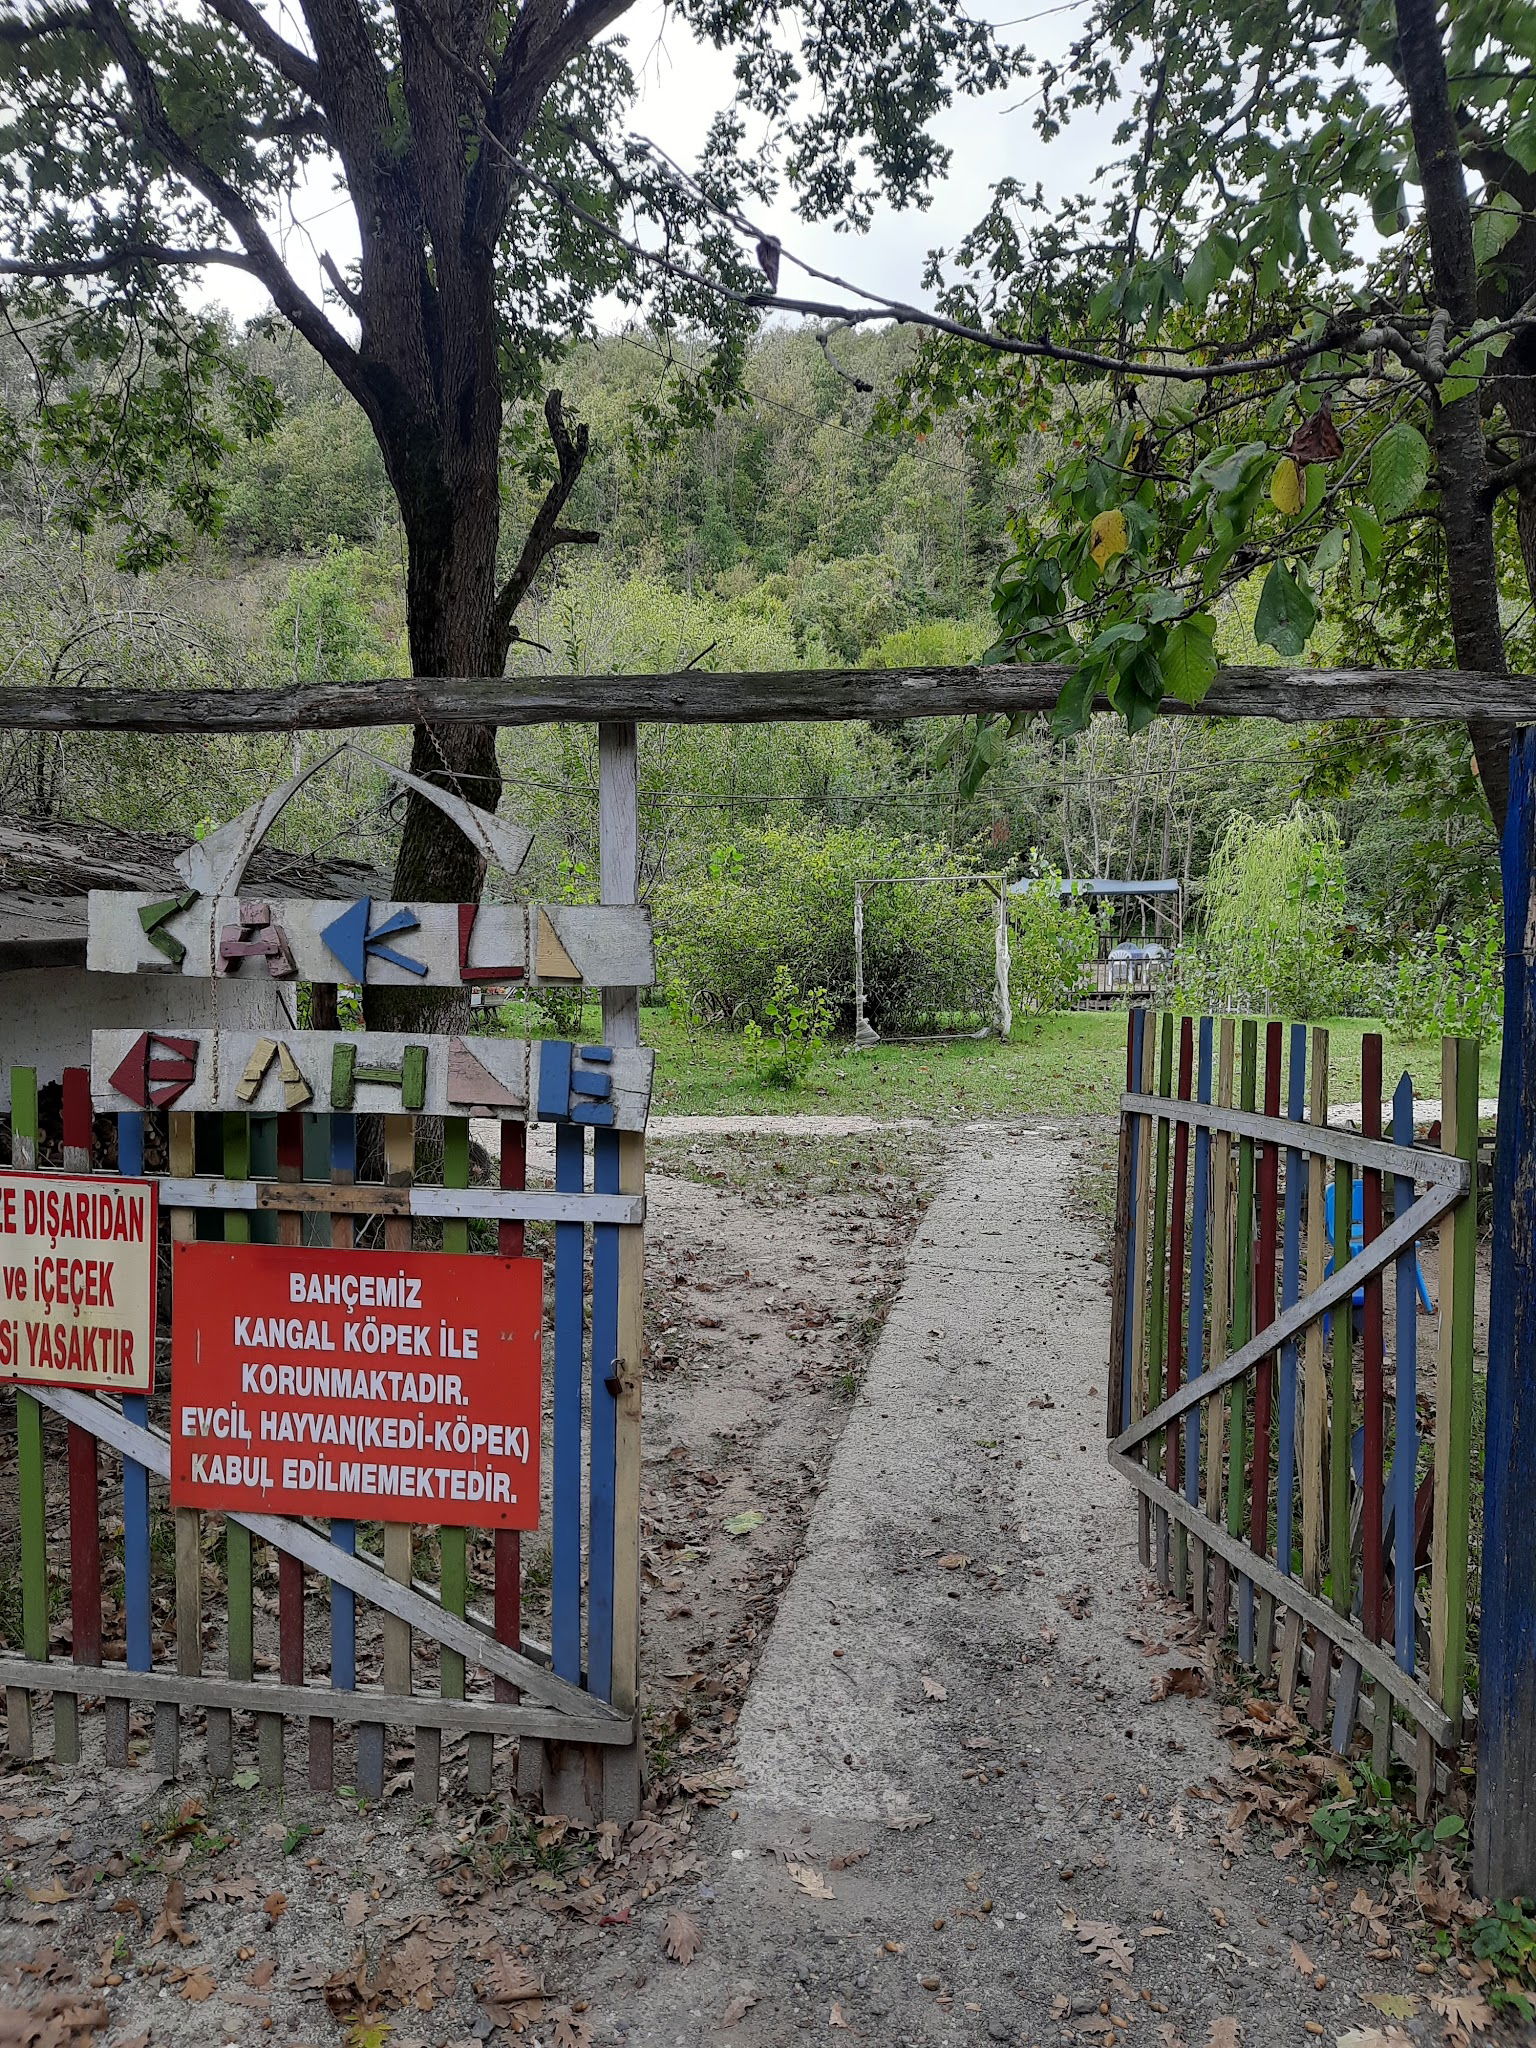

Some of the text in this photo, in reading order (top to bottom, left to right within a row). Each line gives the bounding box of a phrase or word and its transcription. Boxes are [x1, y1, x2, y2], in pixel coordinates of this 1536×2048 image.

[0, 1187, 144, 1249] E DIŞARIDAN
[3, 1266, 27, 1301] ve
[289, 1270, 422, 1314] BAHÇEMİZ
[25, 1321, 135, 1375] YASAKTIR
[234, 1315, 479, 1360] KANGAL KÖPEK İLE
[242, 1363, 469, 1406] KORUNMAKTADIR.
[181, 1401, 530, 1464] EVCİL HAYVAN(KEDİ-KÖPEK)
[191, 1452, 518, 1504] KABUL EDİLMEMEKTEDİR.
